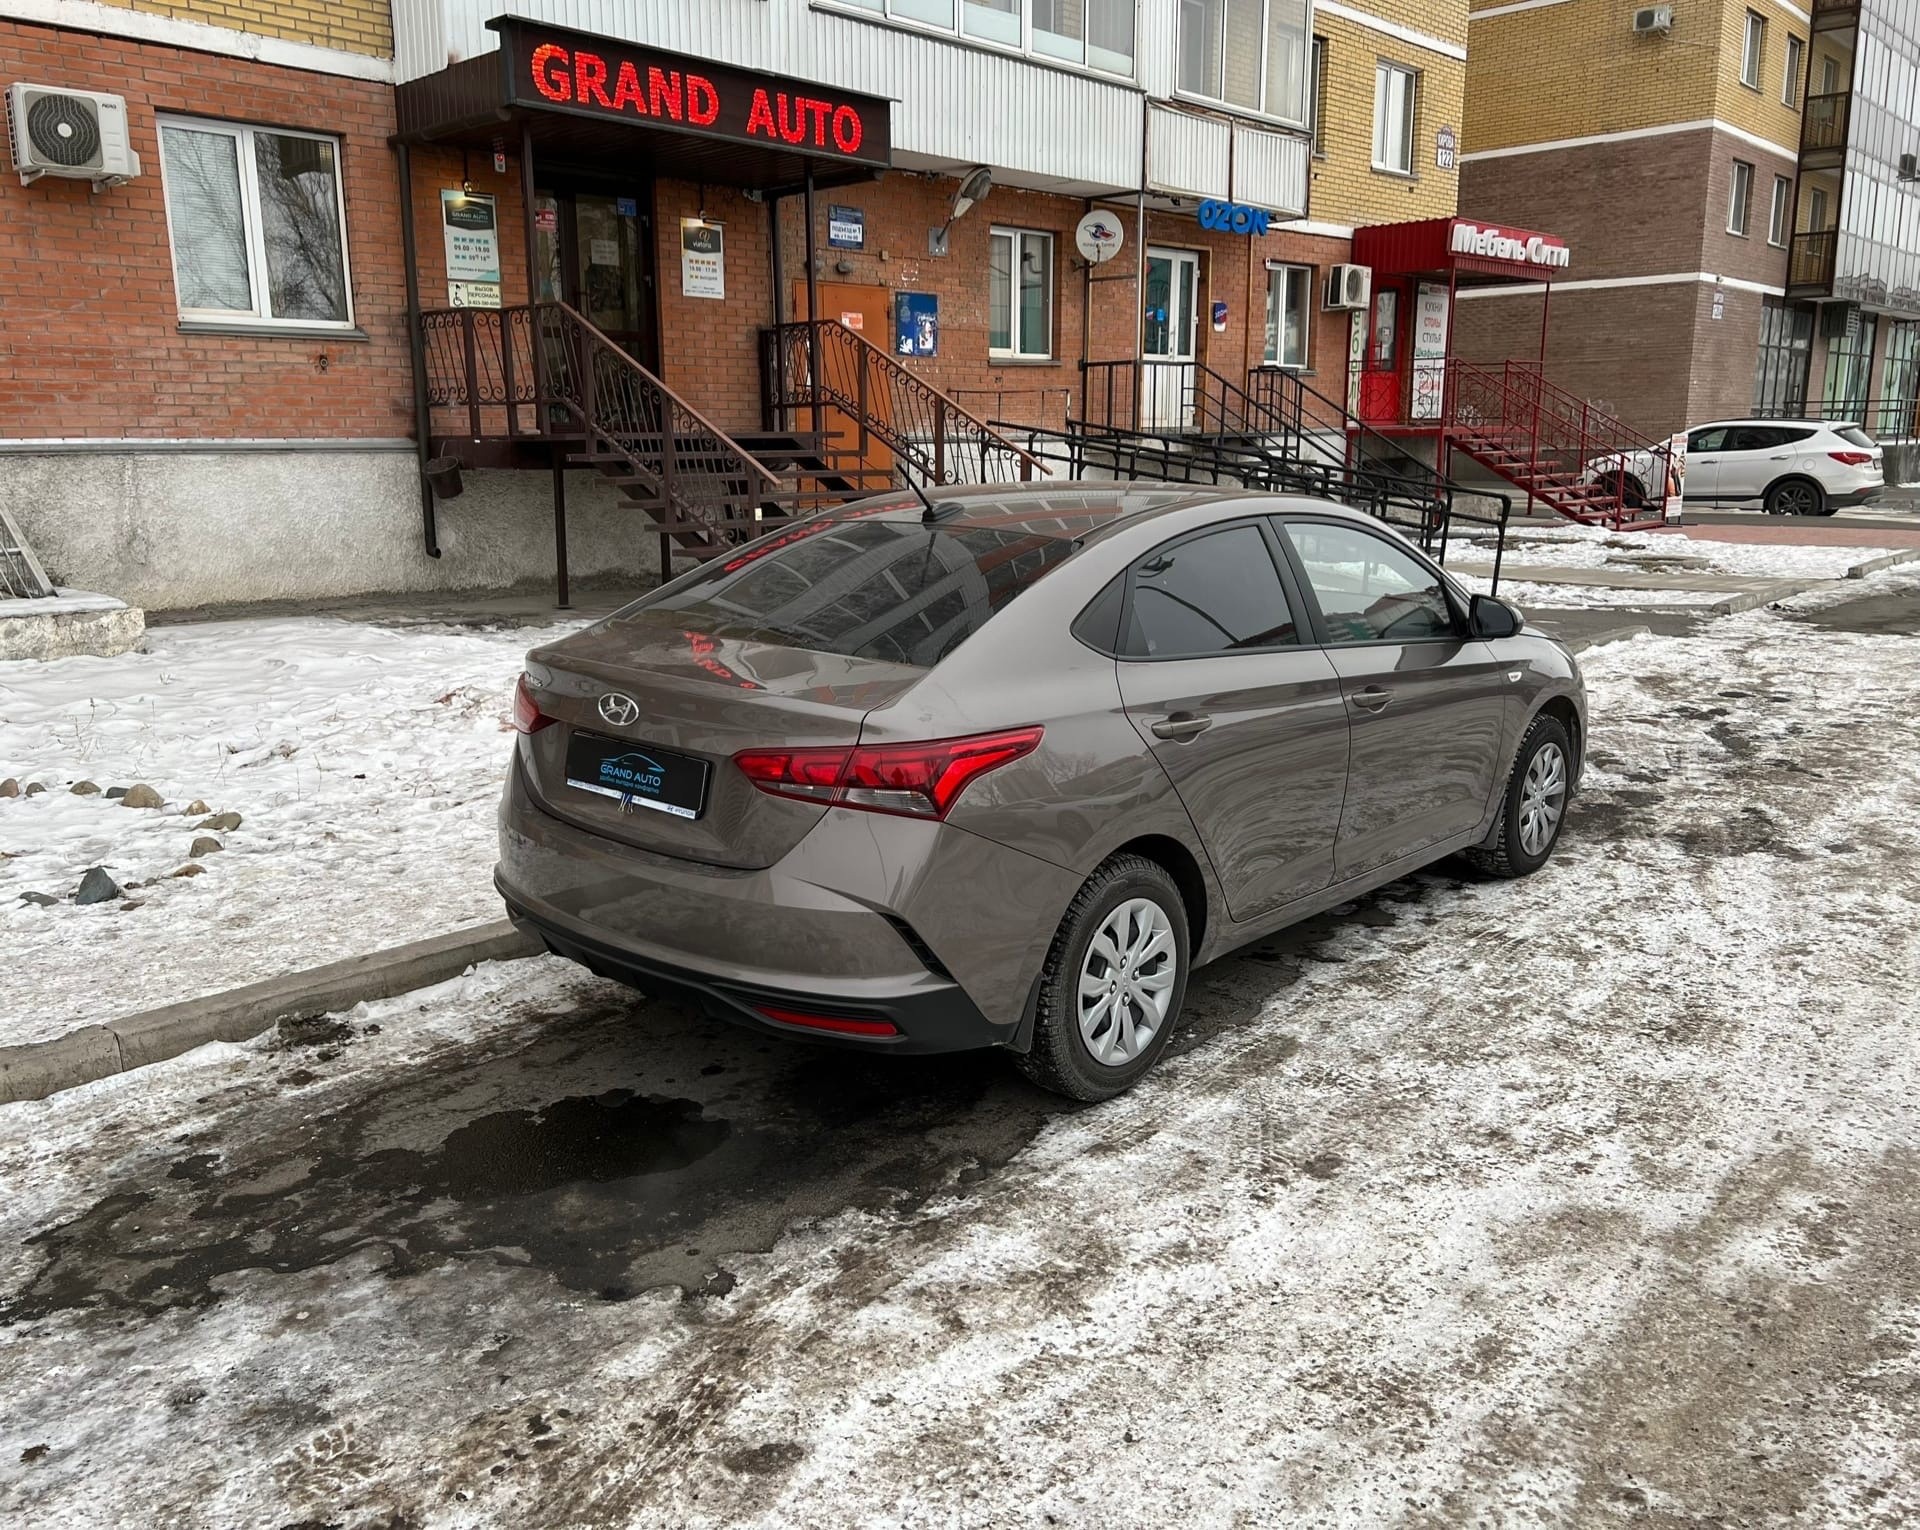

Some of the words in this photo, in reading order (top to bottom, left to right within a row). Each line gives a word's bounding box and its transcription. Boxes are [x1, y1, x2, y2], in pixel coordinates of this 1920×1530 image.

[531, 43, 720, 126] GRAND
[746, 88, 862, 153] AUTO
[1440, 151, 1452, 167] 122
[451, 211, 472, 219] GRAND
[1197, 198, 1270, 237] OZON
[1451, 223, 1526, 261] Мебель
[1526, 237, 1570, 267] Сити
[1424, 301, 1443, 313] КУХНИ
[1423, 316, 1442, 328] СТОЛЫ
[1422, 332, 1442, 344] СТУЛЬЯ
[600, 764, 633, 780] GRAND
[633, 772, 661, 786] AUTO
